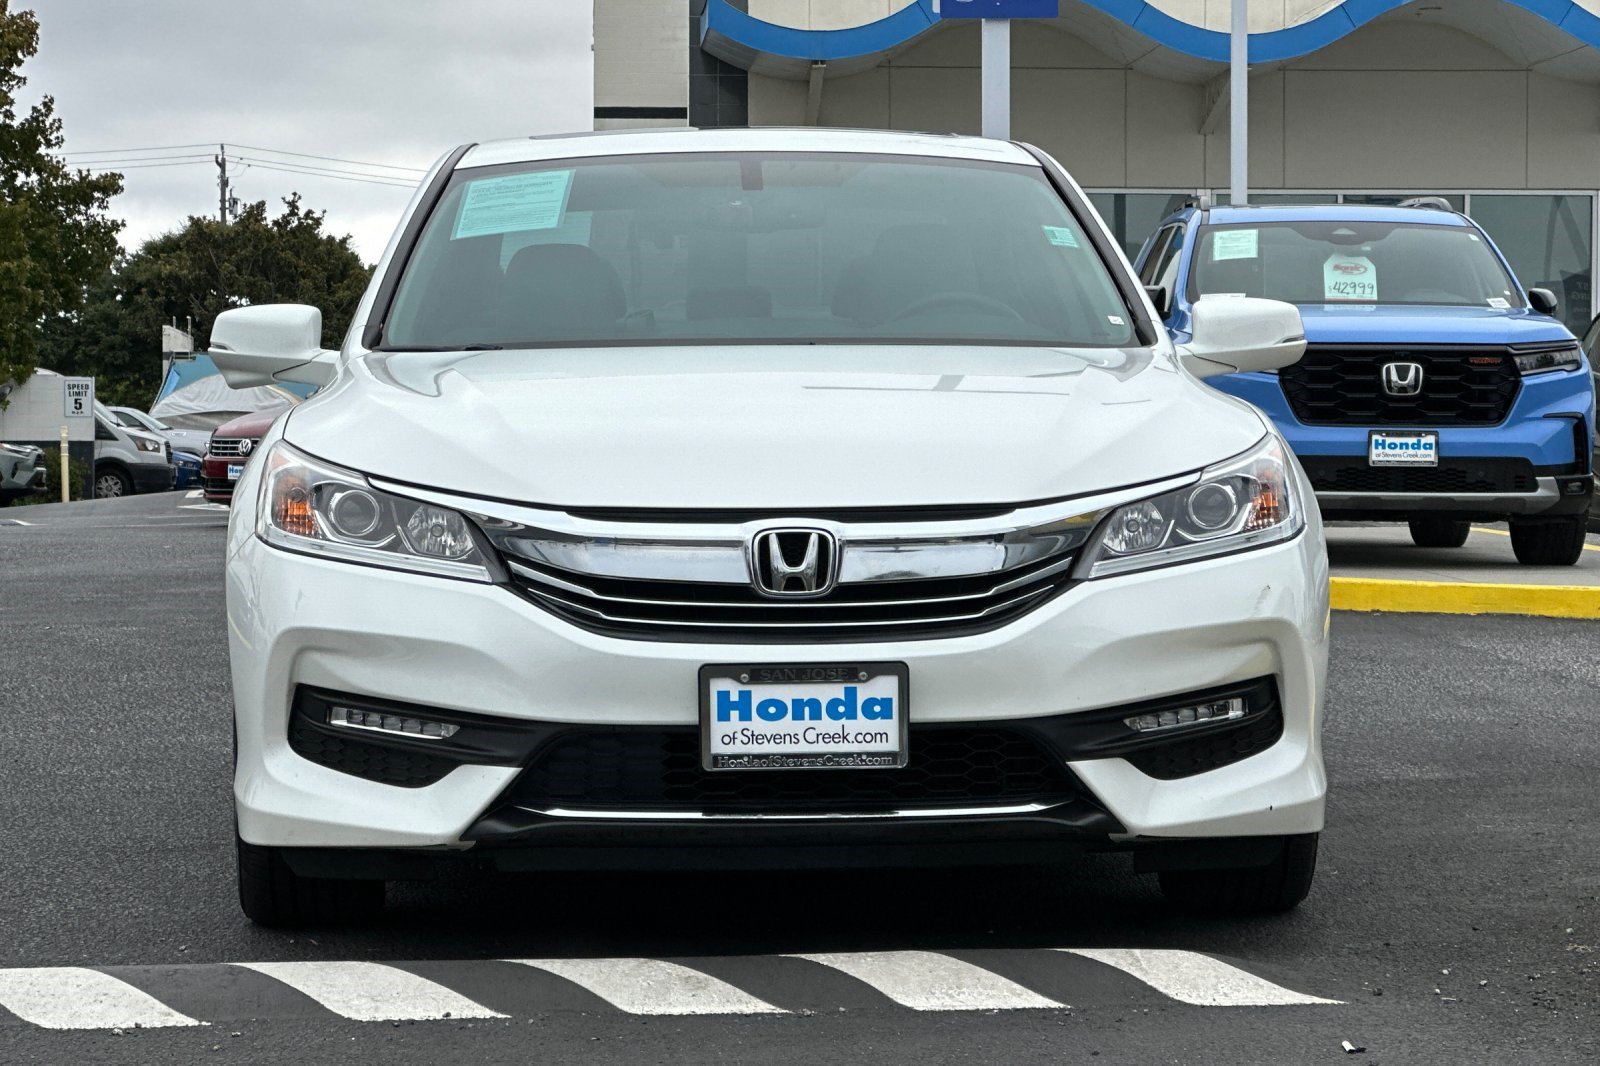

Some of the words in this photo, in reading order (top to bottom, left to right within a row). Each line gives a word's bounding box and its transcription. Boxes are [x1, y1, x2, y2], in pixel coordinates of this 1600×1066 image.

[74, 398, 83, 411] 5
[1374, 438, 1433, 450] Honda
[760, 668, 796, 680] SAN
[803, 668, 849, 680] JOSE
[717, 686, 894, 722] Honda
[721, 731, 739, 746] of
[740, 727, 800, 745] Stevens
[803, 724, 889, 745] Creek.com
